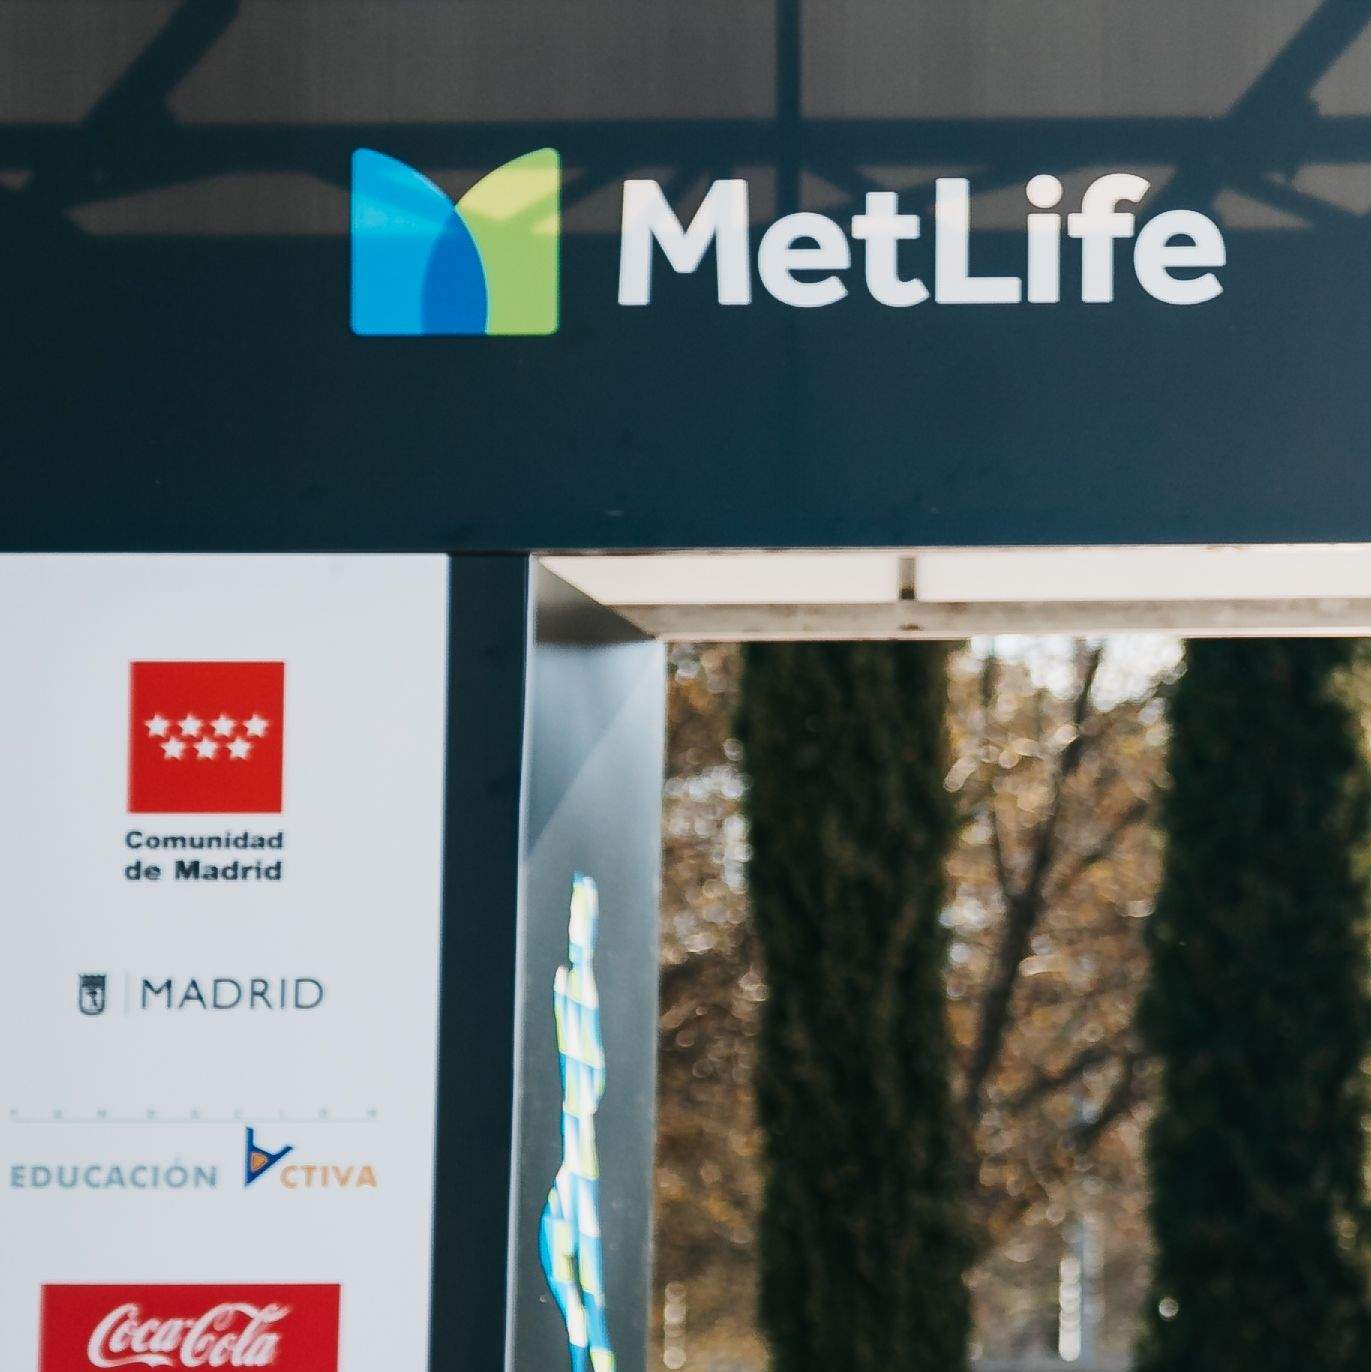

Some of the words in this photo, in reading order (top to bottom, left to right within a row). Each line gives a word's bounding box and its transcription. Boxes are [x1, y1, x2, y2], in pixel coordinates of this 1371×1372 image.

[617, 171, 1227, 308] MetLife
[124, 830, 284, 850] Comunidad
[124, 860, 162, 881] de
[174, 859, 282, 881] Madrid
[140, 977, 325, 1010] MADRID
[10, 1158, 217, 1189] EDUCACIÓN
[87, 1302, 290, 1369] Coca-Cola
